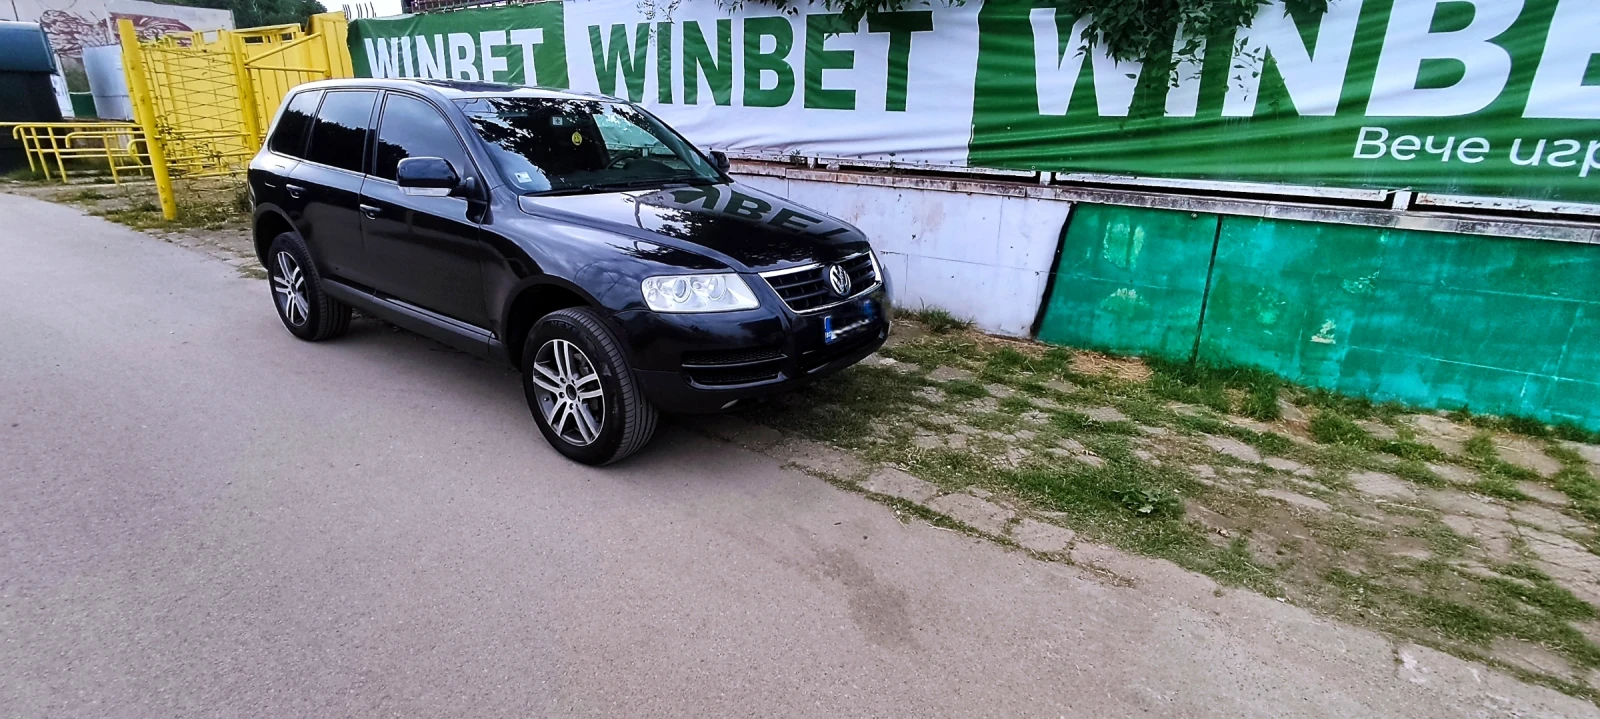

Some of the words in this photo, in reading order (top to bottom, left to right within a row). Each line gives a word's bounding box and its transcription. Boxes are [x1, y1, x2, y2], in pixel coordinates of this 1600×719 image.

[364, 28, 544, 87] WINBET
[588, 10, 933, 112] WINBET
[1352, 126, 1491, 163] Вече
